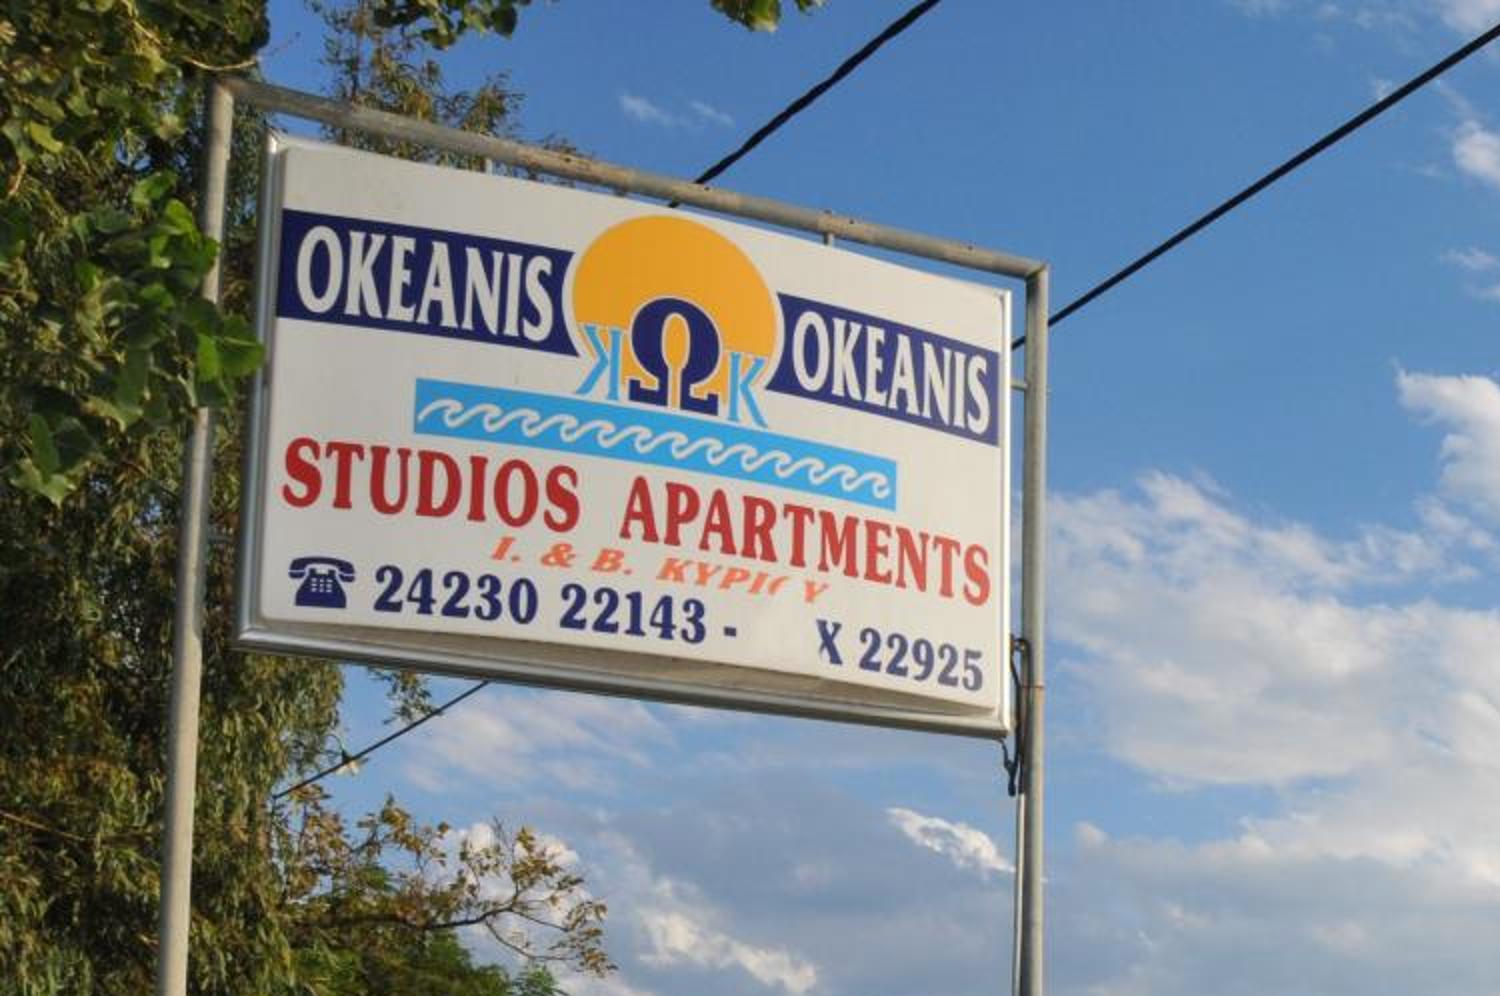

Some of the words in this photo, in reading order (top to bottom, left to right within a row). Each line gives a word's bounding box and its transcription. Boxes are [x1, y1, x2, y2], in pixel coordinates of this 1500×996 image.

[297, 225, 553, 342] OKEANIS
[792, 310, 991, 434] OKEANIS
[281, 436, 581, 533] STUDIOS
[619, 475, 991, 606] APARTMENTS
[373, 565, 538, 625] 24230
[559, 583, 706, 642] 22143
[859, 627, 983, 691] 22925
